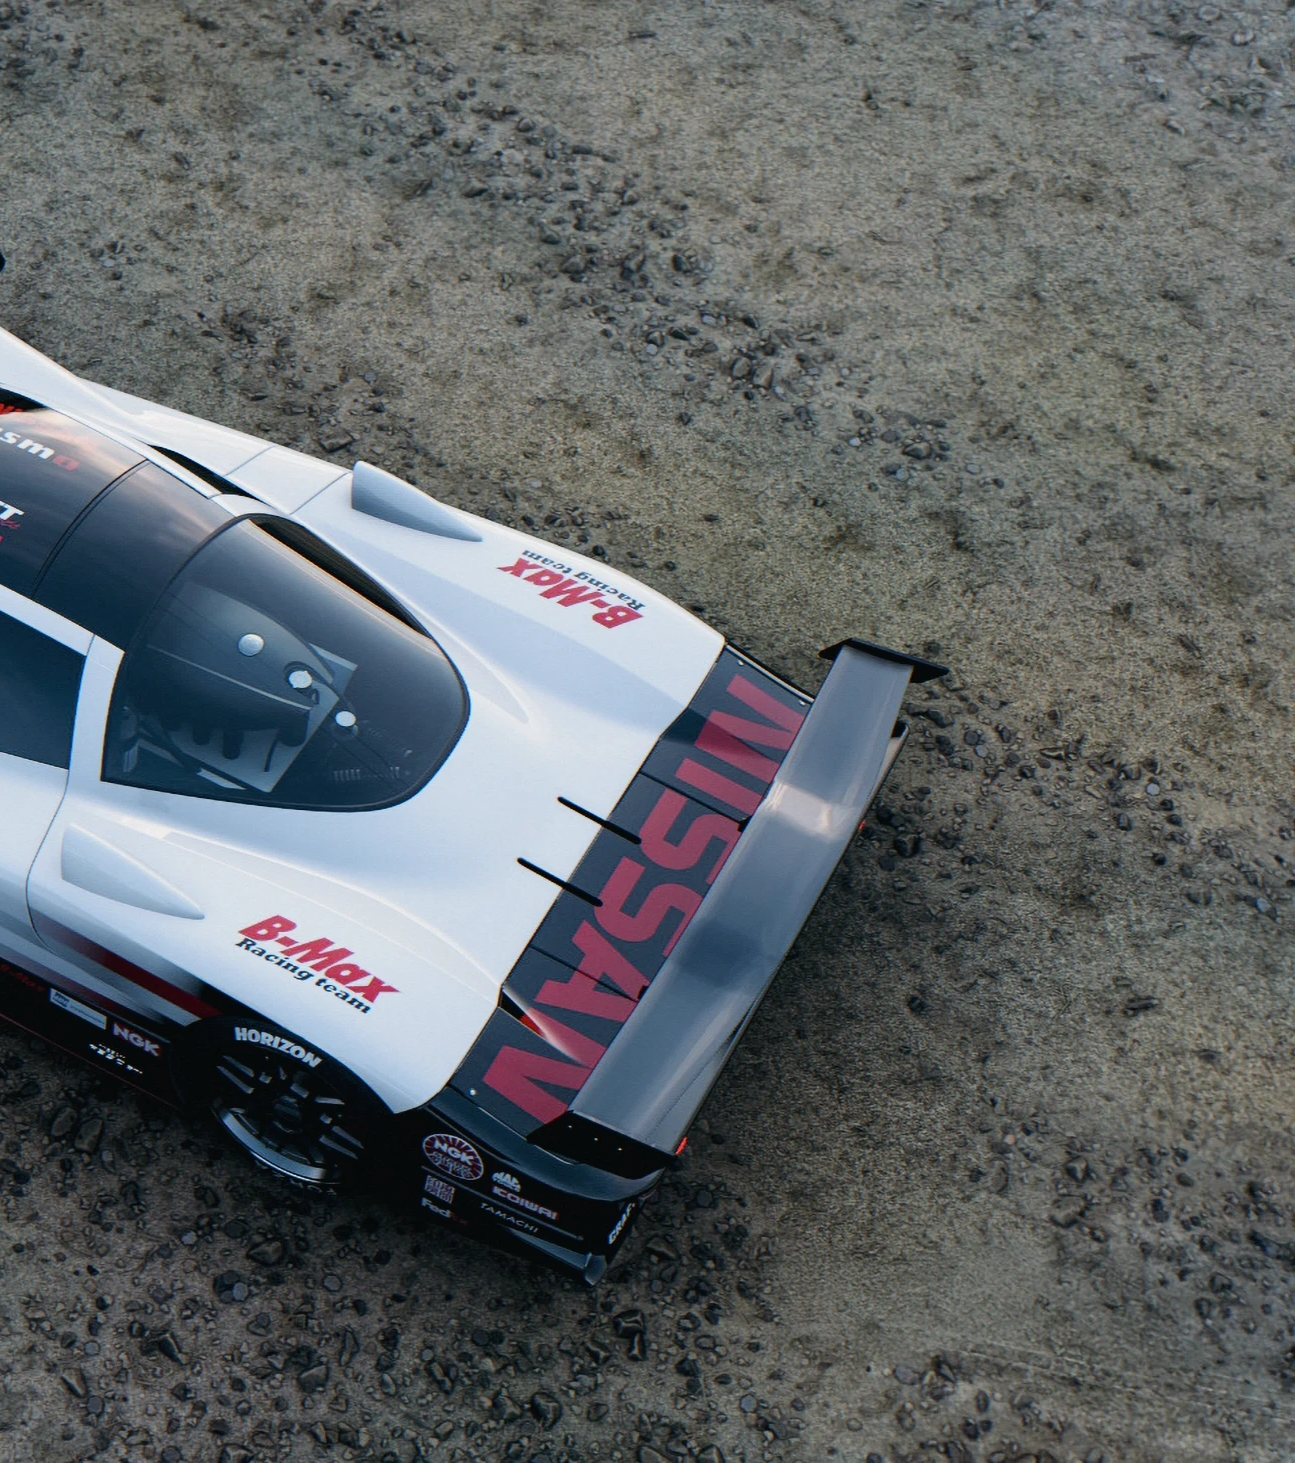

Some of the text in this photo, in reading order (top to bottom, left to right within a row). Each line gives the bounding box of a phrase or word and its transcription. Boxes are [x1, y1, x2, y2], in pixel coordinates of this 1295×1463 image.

[496, 558, 644, 629] B-Max
[522, 550, 646, 611] Racing team
[482, 674, 806, 1125] NISSAN
[235, 937, 372, 1014] Racing team
[238, 914, 402, 1003] B-Max
[113, 1022, 160, 1057] NGK
[234, 1026, 323, 1069] HORIZON
[433, 1139, 475, 1166] NGK
[481, 1202, 539, 1233] TAMACHI
